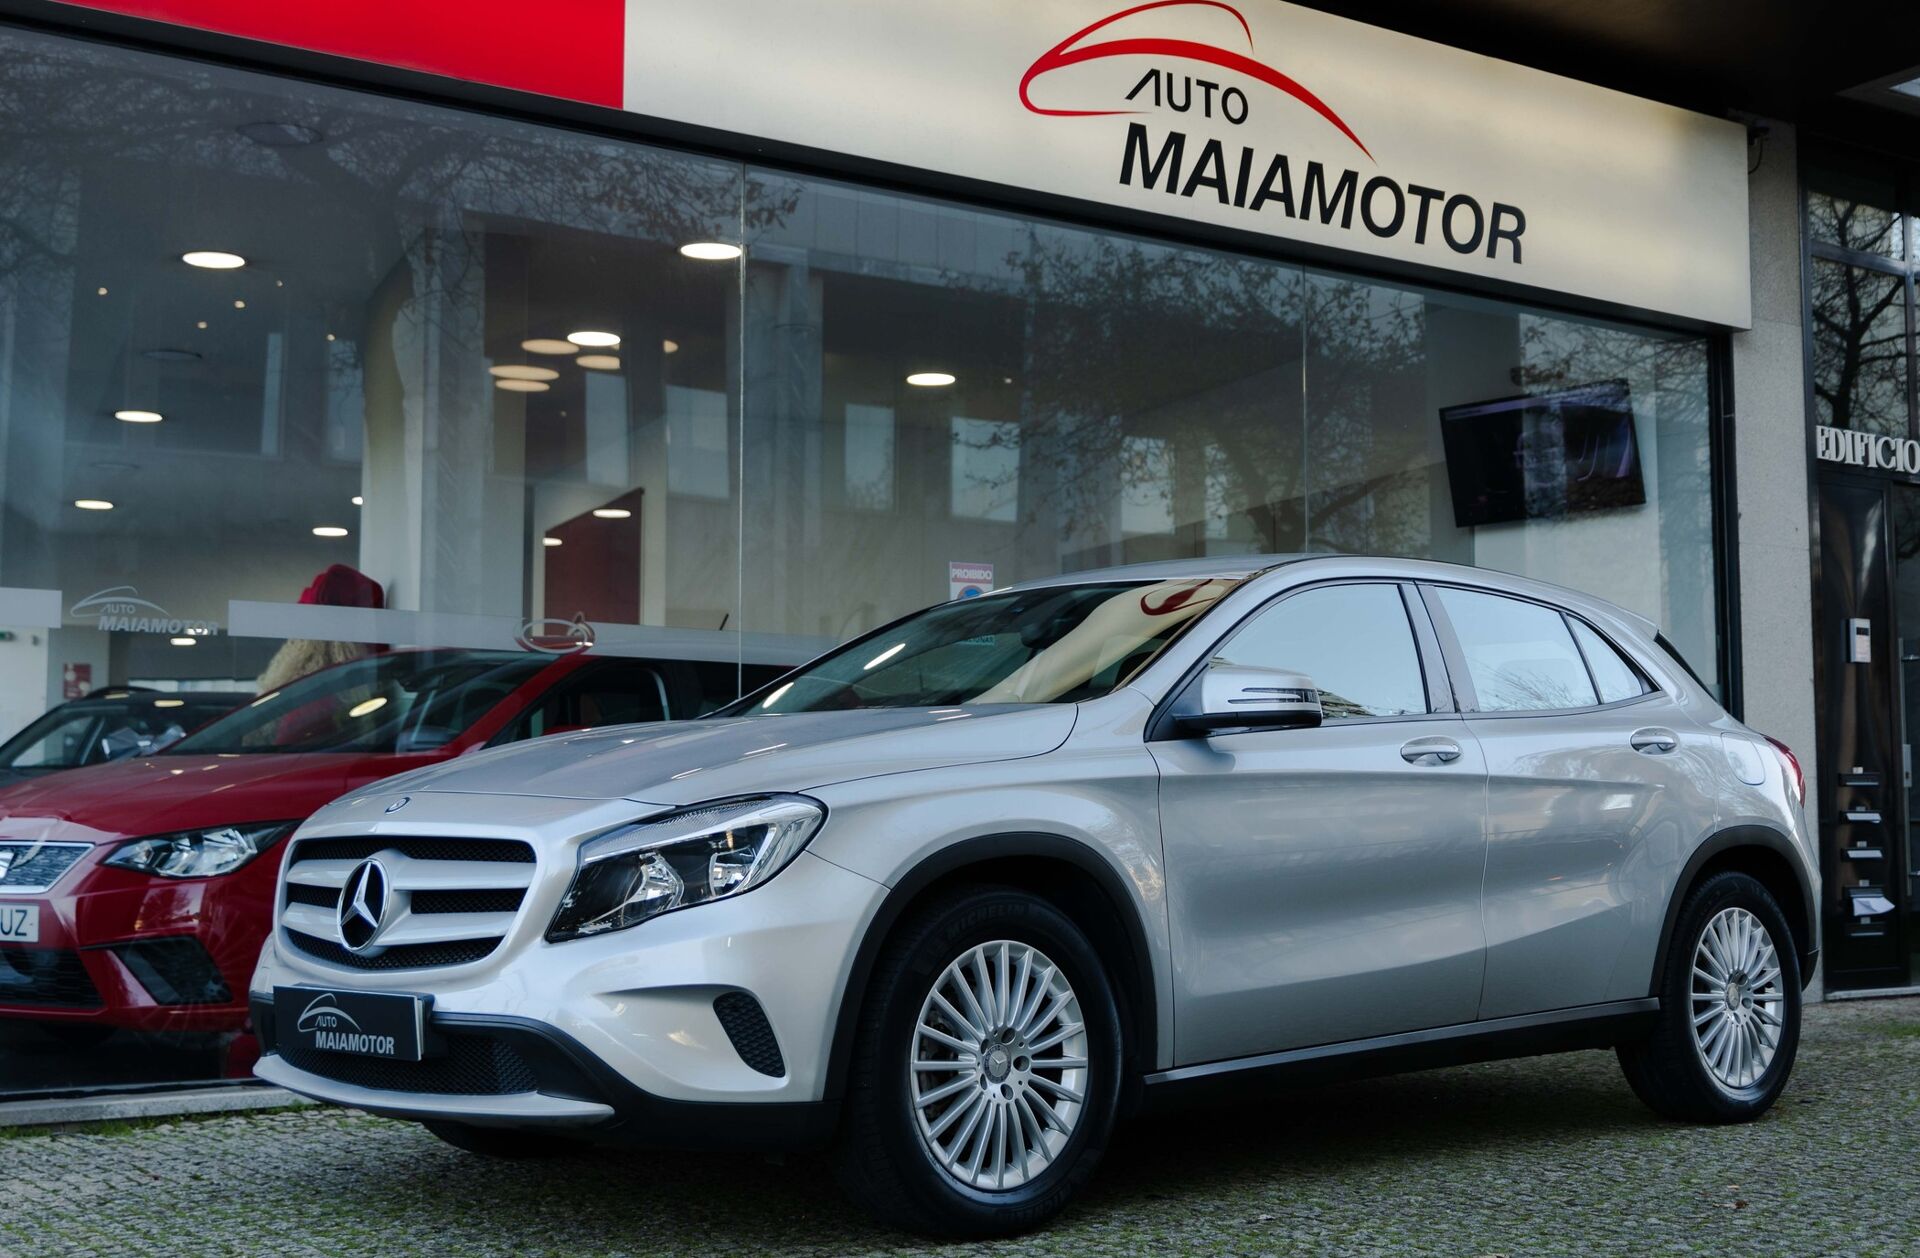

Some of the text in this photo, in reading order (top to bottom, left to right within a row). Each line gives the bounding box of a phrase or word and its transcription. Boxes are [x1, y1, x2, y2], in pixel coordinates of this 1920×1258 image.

[1124, 68, 1249, 125] AUTO
[1119, 122, 1527, 264] MAIAMOTOR
[1816, 425, 1920, 474] EDIFICIO
[952, 568, 992, 580] PROIBIDO
[101, 604, 136, 614] AUTO
[98, 616, 219, 636] MAIAMOTOR
[0, 909, 27, 936] UZ
[315, 1016, 337, 1028] AUTO
[315, 1031, 395, 1055] MAIAMOTOR
